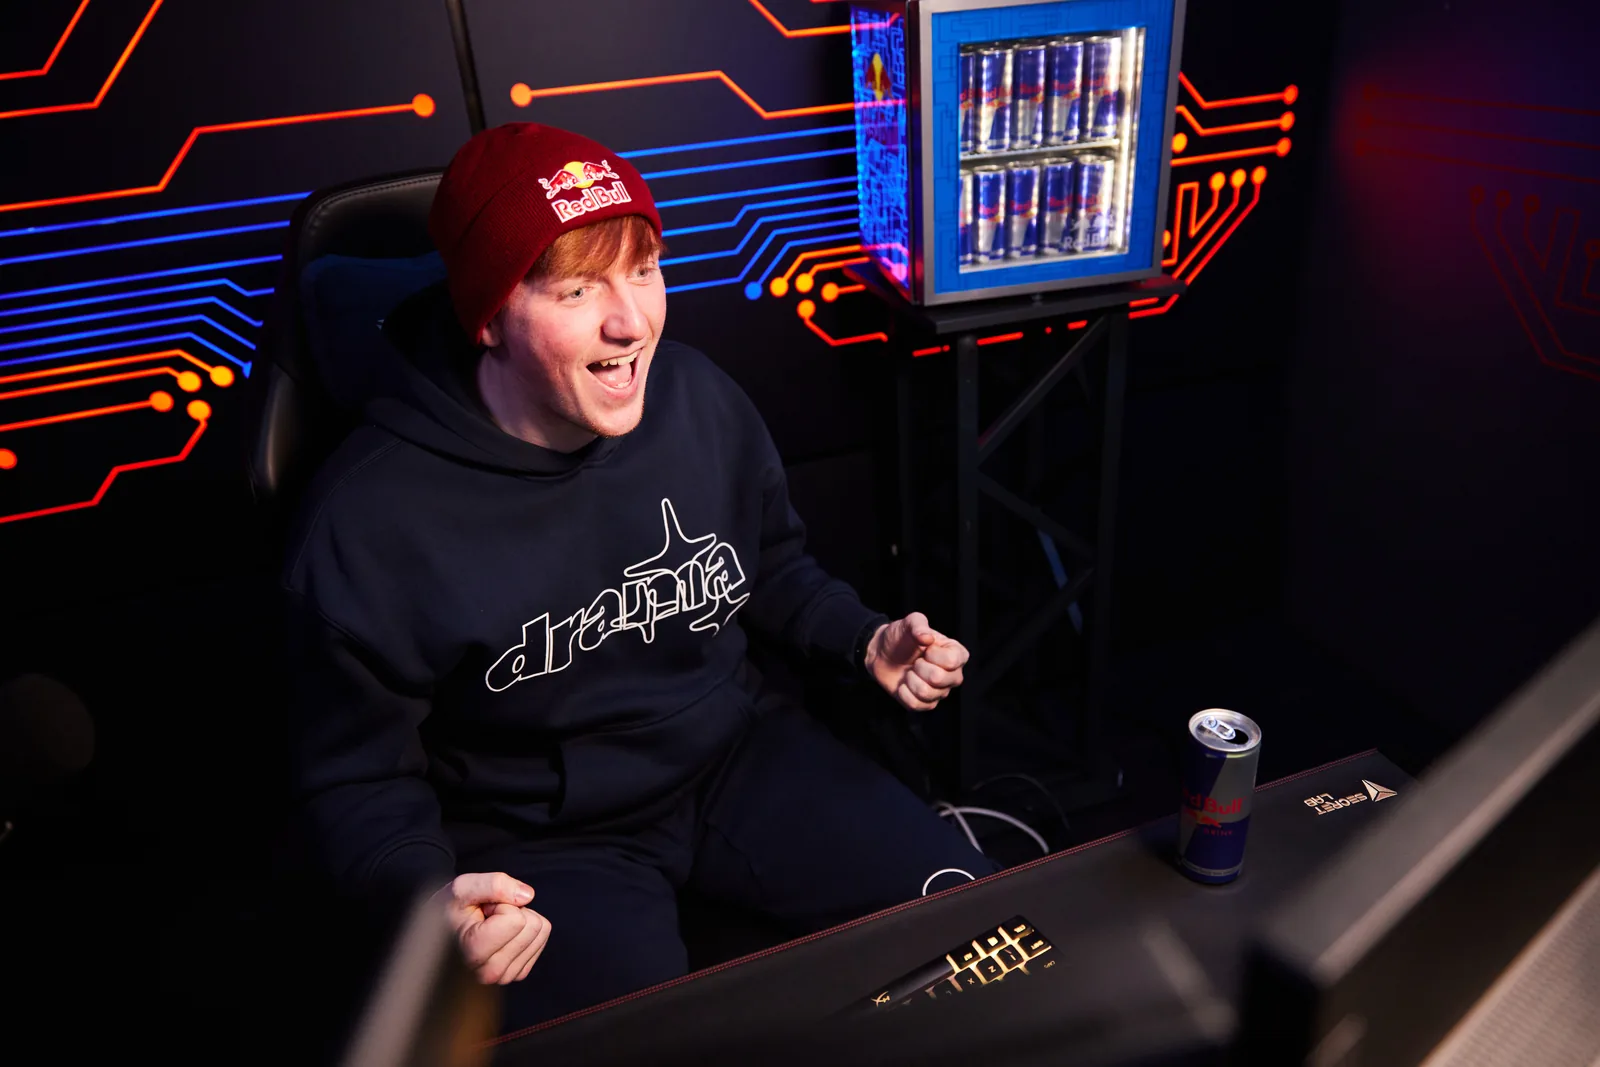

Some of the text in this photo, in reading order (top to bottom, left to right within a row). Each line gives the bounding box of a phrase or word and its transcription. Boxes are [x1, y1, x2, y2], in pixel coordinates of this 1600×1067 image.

[551, 181, 632, 223] Red Bull
[1204, 797, 1243, 815] Bull
[1303, 792, 1334, 807] LAB
[1314, 792, 1368, 816] SECRET
